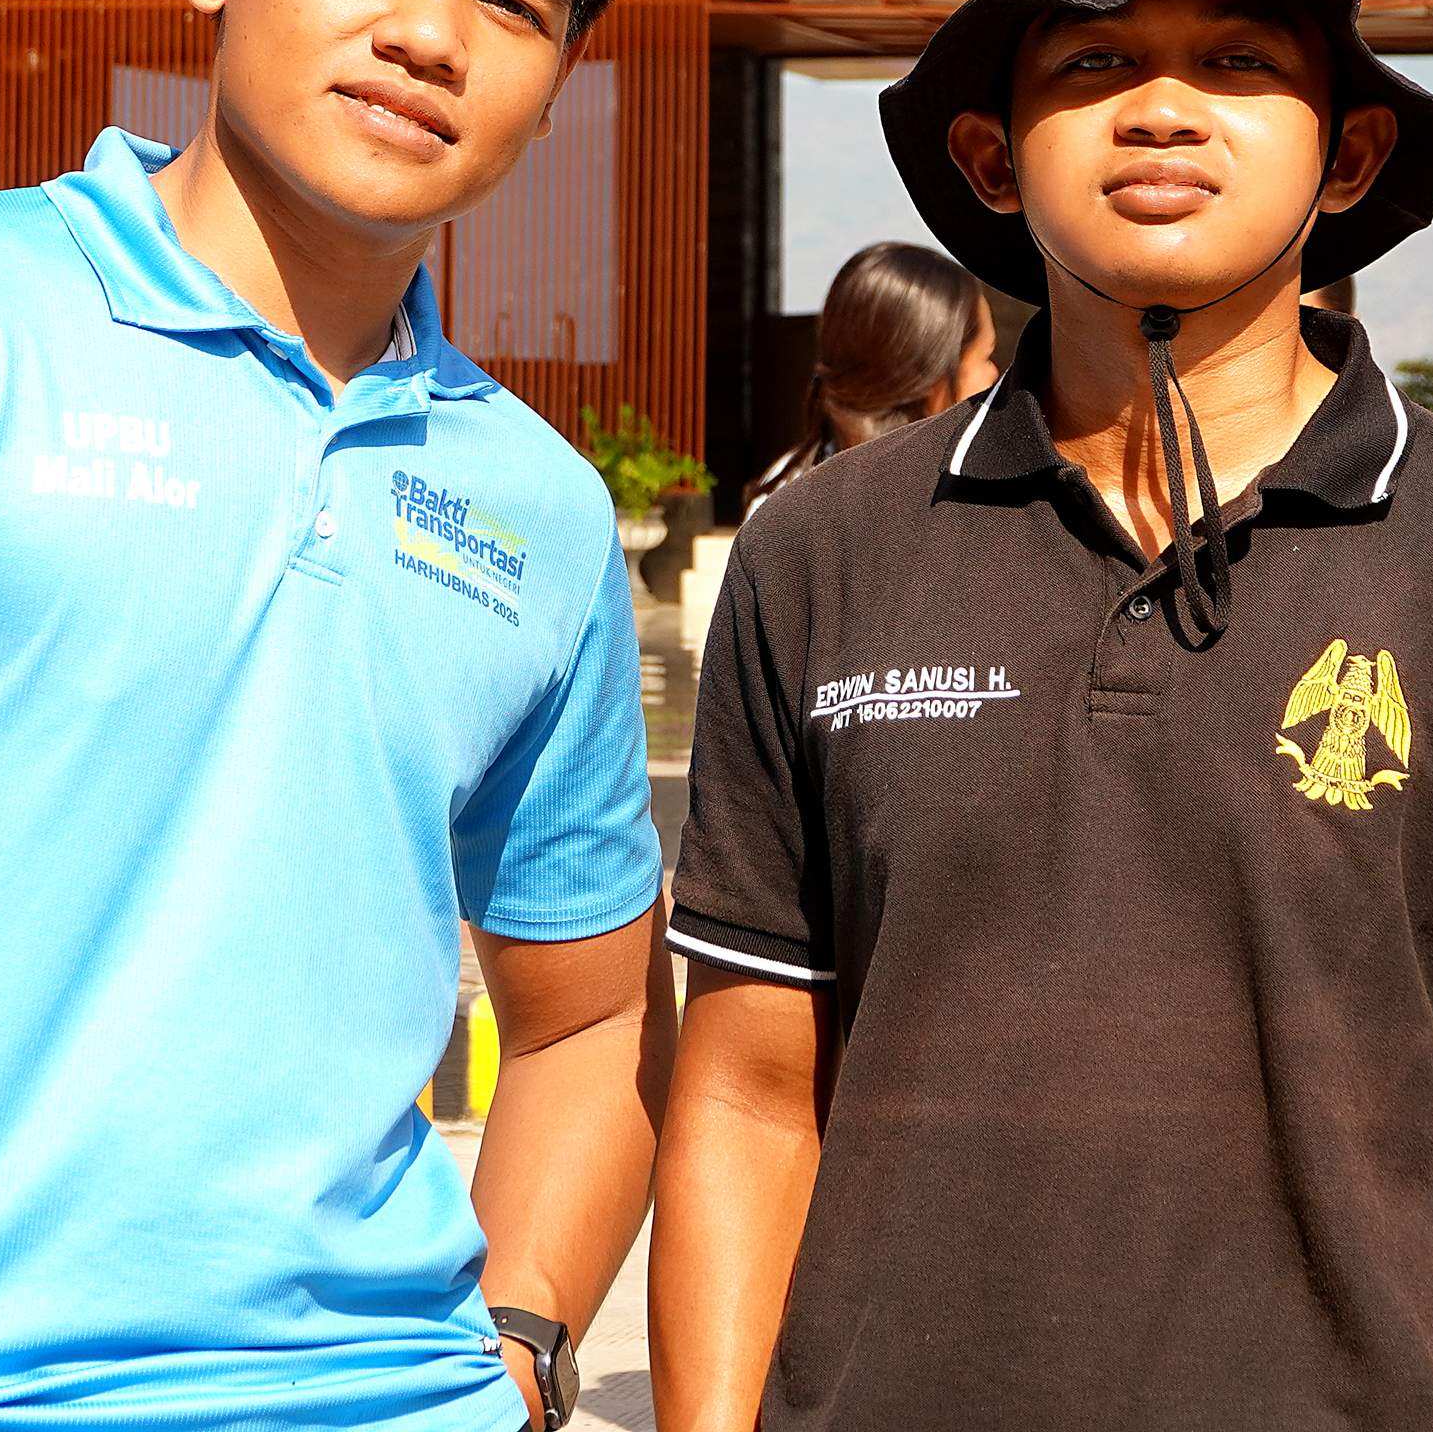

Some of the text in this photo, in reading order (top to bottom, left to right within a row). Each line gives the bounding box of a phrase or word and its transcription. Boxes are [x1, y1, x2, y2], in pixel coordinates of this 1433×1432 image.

[63, 410, 171, 457] UPBU
[32, 454, 201, 509] Mali Alor
[409, 474, 471, 528] Bakti
[390, 488, 527, 581] Transportasi
[394, 548, 520, 628] HARHUBNAS 2025
[815, 665, 1012, 708] ERWIN SANUSI H.
[856, 699, 983, 724] 15062210007
